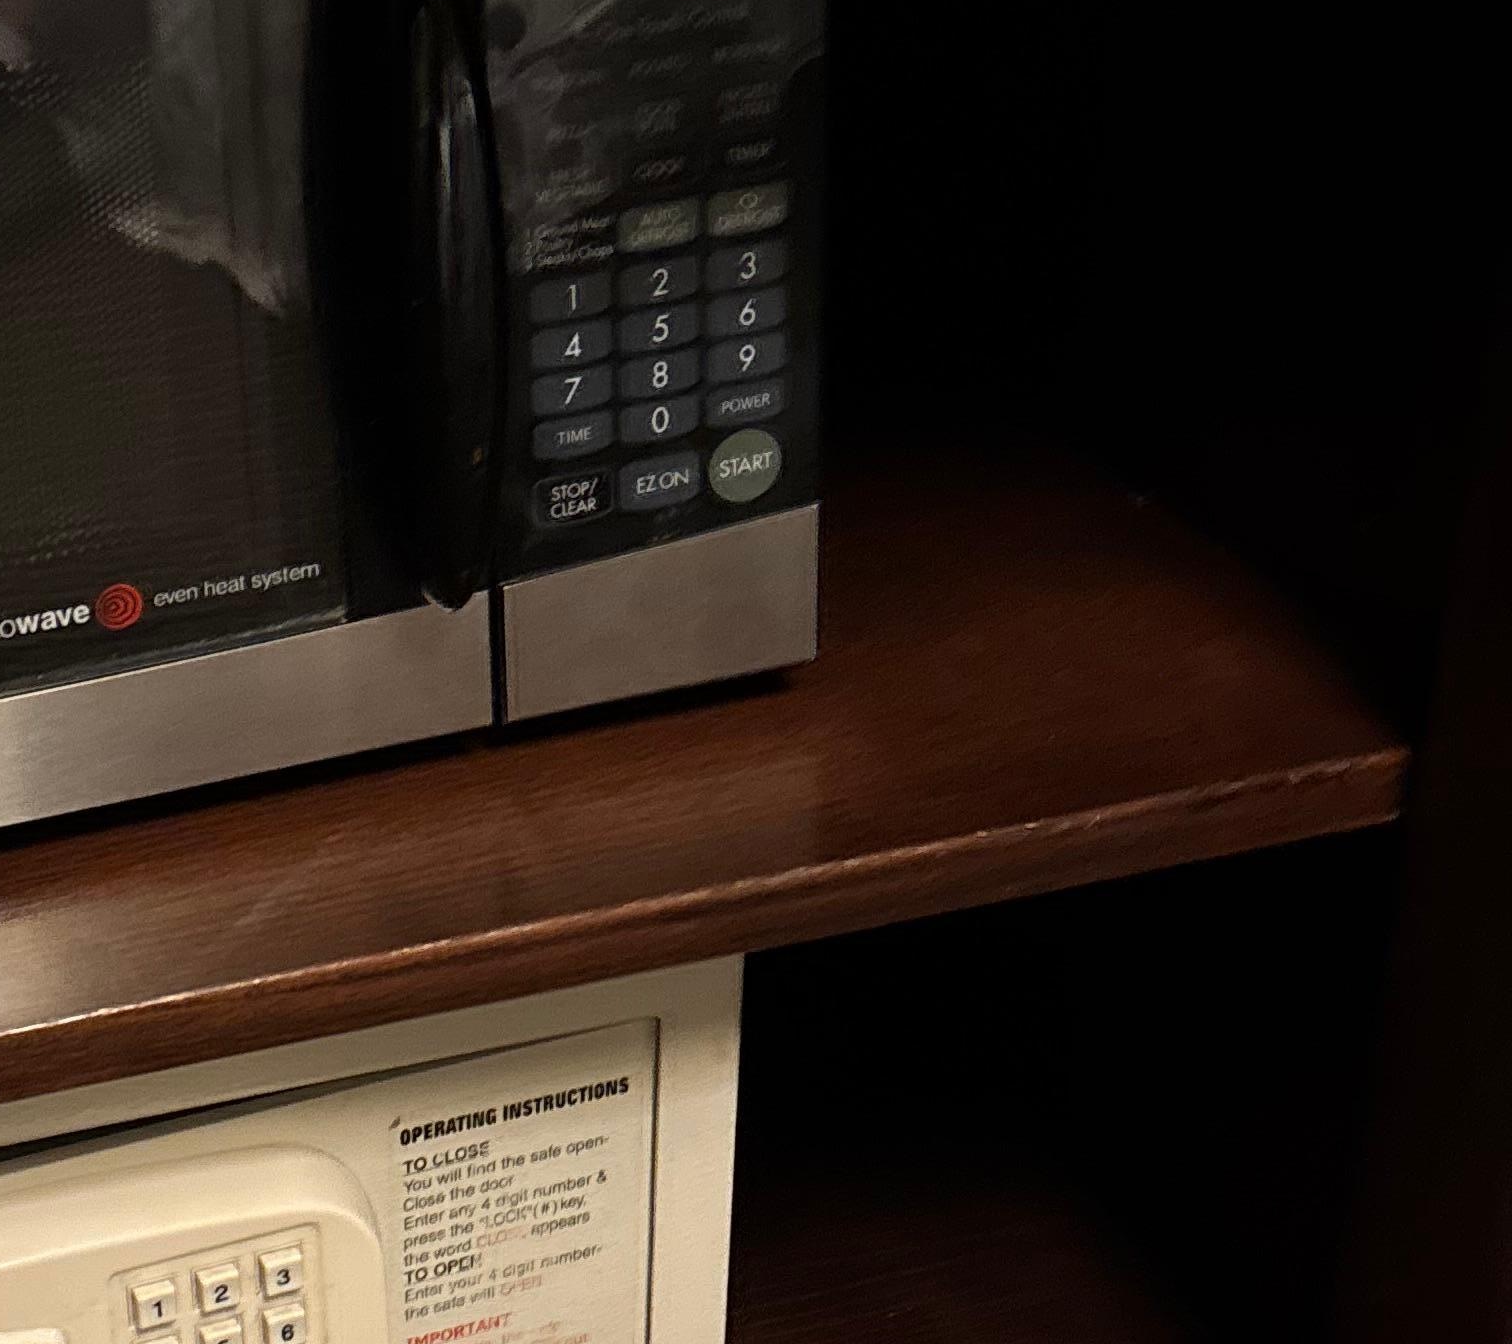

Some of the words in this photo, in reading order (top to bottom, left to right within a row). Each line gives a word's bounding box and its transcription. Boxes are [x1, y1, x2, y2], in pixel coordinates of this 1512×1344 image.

[565, 283, 578, 312] 1
[651, 267, 670, 298] 2
[739, 251, 758, 280] 3
[563, 331, 583, 358] 4
[652, 314, 670, 343] 5
[738, 298, 757, 327] 6
[563, 376, 583, 406] 7
[652, 361, 669, 389] 8
[739, 344, 757, 373] 9
[555, 426, 592, 446] TIME
[651, 406, 670, 434] 0
[719, 392, 771, 414] POWER
[636, 475, 657, 496] EZ
[660, 469, 690, 490] ON
[718, 451, 774, 479] START
[550, 477, 599, 503] STOP/
[550, 497, 597, 519] CLEAR
[153, 584, 199, 608] even
[203, 575, 245, 598] heat
[251, 561, 321, 592] system
[399, 1107, 497, 1147] OPERATING
[501, 1076, 630, 1123] INSTRUCTIONS
[402, 1155, 428, 1175] TO
[432, 1140, 491, 1167] CLOSE
[403, 1176, 433, 1195] You
[436, 1166, 463, 1186] will
[466, 1159, 497, 1178] find
[501, 1153, 525, 1170] the
[529, 1143, 562, 1163] safe
[402, 1191, 446, 1213] Close
[449, 1184, 476, 1202] the
[479, 1174, 514, 1194] door
[404, 1210, 445, 1232] Enter
[449, 1203, 477, 1221] any
[480, 1196, 491, 1210] 4
[496, 1187, 529, 1208] digit
[532, 1174, 593, 1199] number
[596, 1169, 608, 1185] &
[403, 1228, 446, 1253] press
[449, 1221, 474, 1238] the
[403, 1251, 429, 1268] the
[433, 1238, 472, 1260] word
[531, 1210, 591, 1237] appears
[153, 1299, 164, 1319] 1
[213, 1283, 230, 1304] 2
[276, 1268, 291, 1287] 3
[404, 1265, 428, 1285] TO
[405, 1283, 444, 1304] Enter
[448, 1272, 483, 1295] your
[488, 1267, 497, 1281] 4
[502, 1258, 535, 1278] digit
[404, 1304, 429, 1322] the
[433, 1295, 465, 1314] safe
[470, 1285, 495, 1305] will
[280, 1323, 295, 1342] 6
